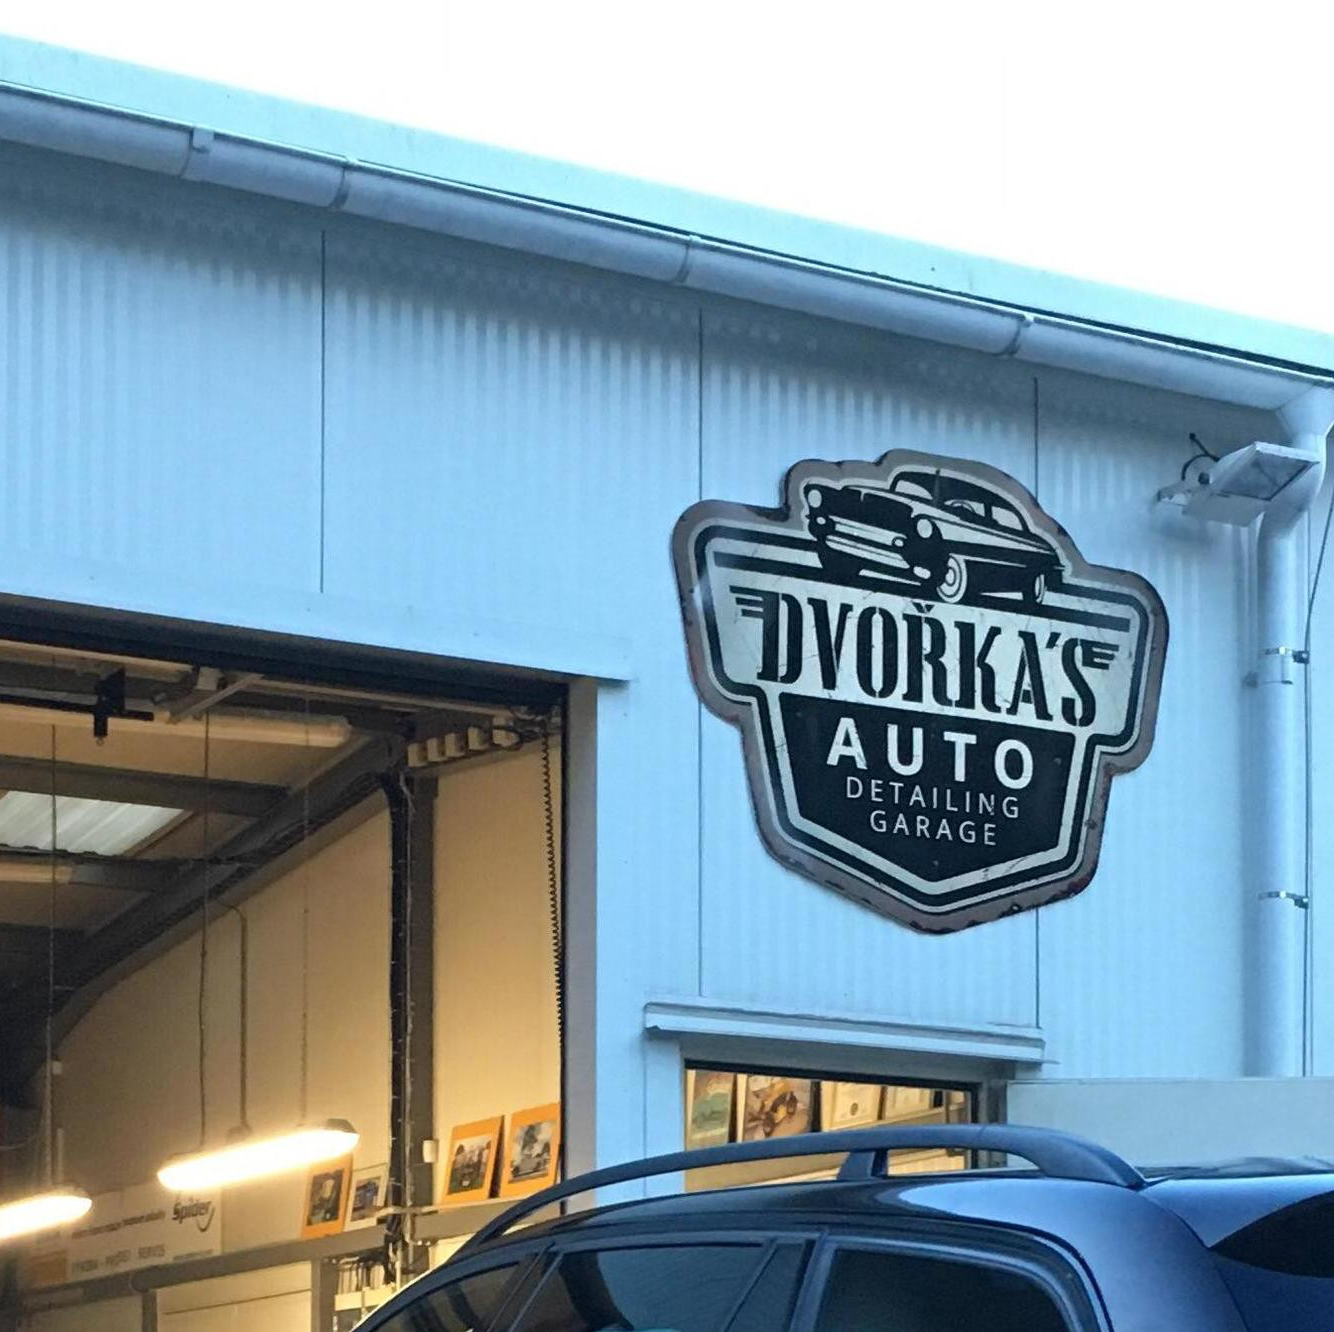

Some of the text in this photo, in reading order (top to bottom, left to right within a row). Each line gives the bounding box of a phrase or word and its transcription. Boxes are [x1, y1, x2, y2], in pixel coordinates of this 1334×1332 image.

[826, 717, 1034, 790] AUTO
[846, 775, 1020, 820] DETAILING
[869, 810, 997, 846] GARAGE
